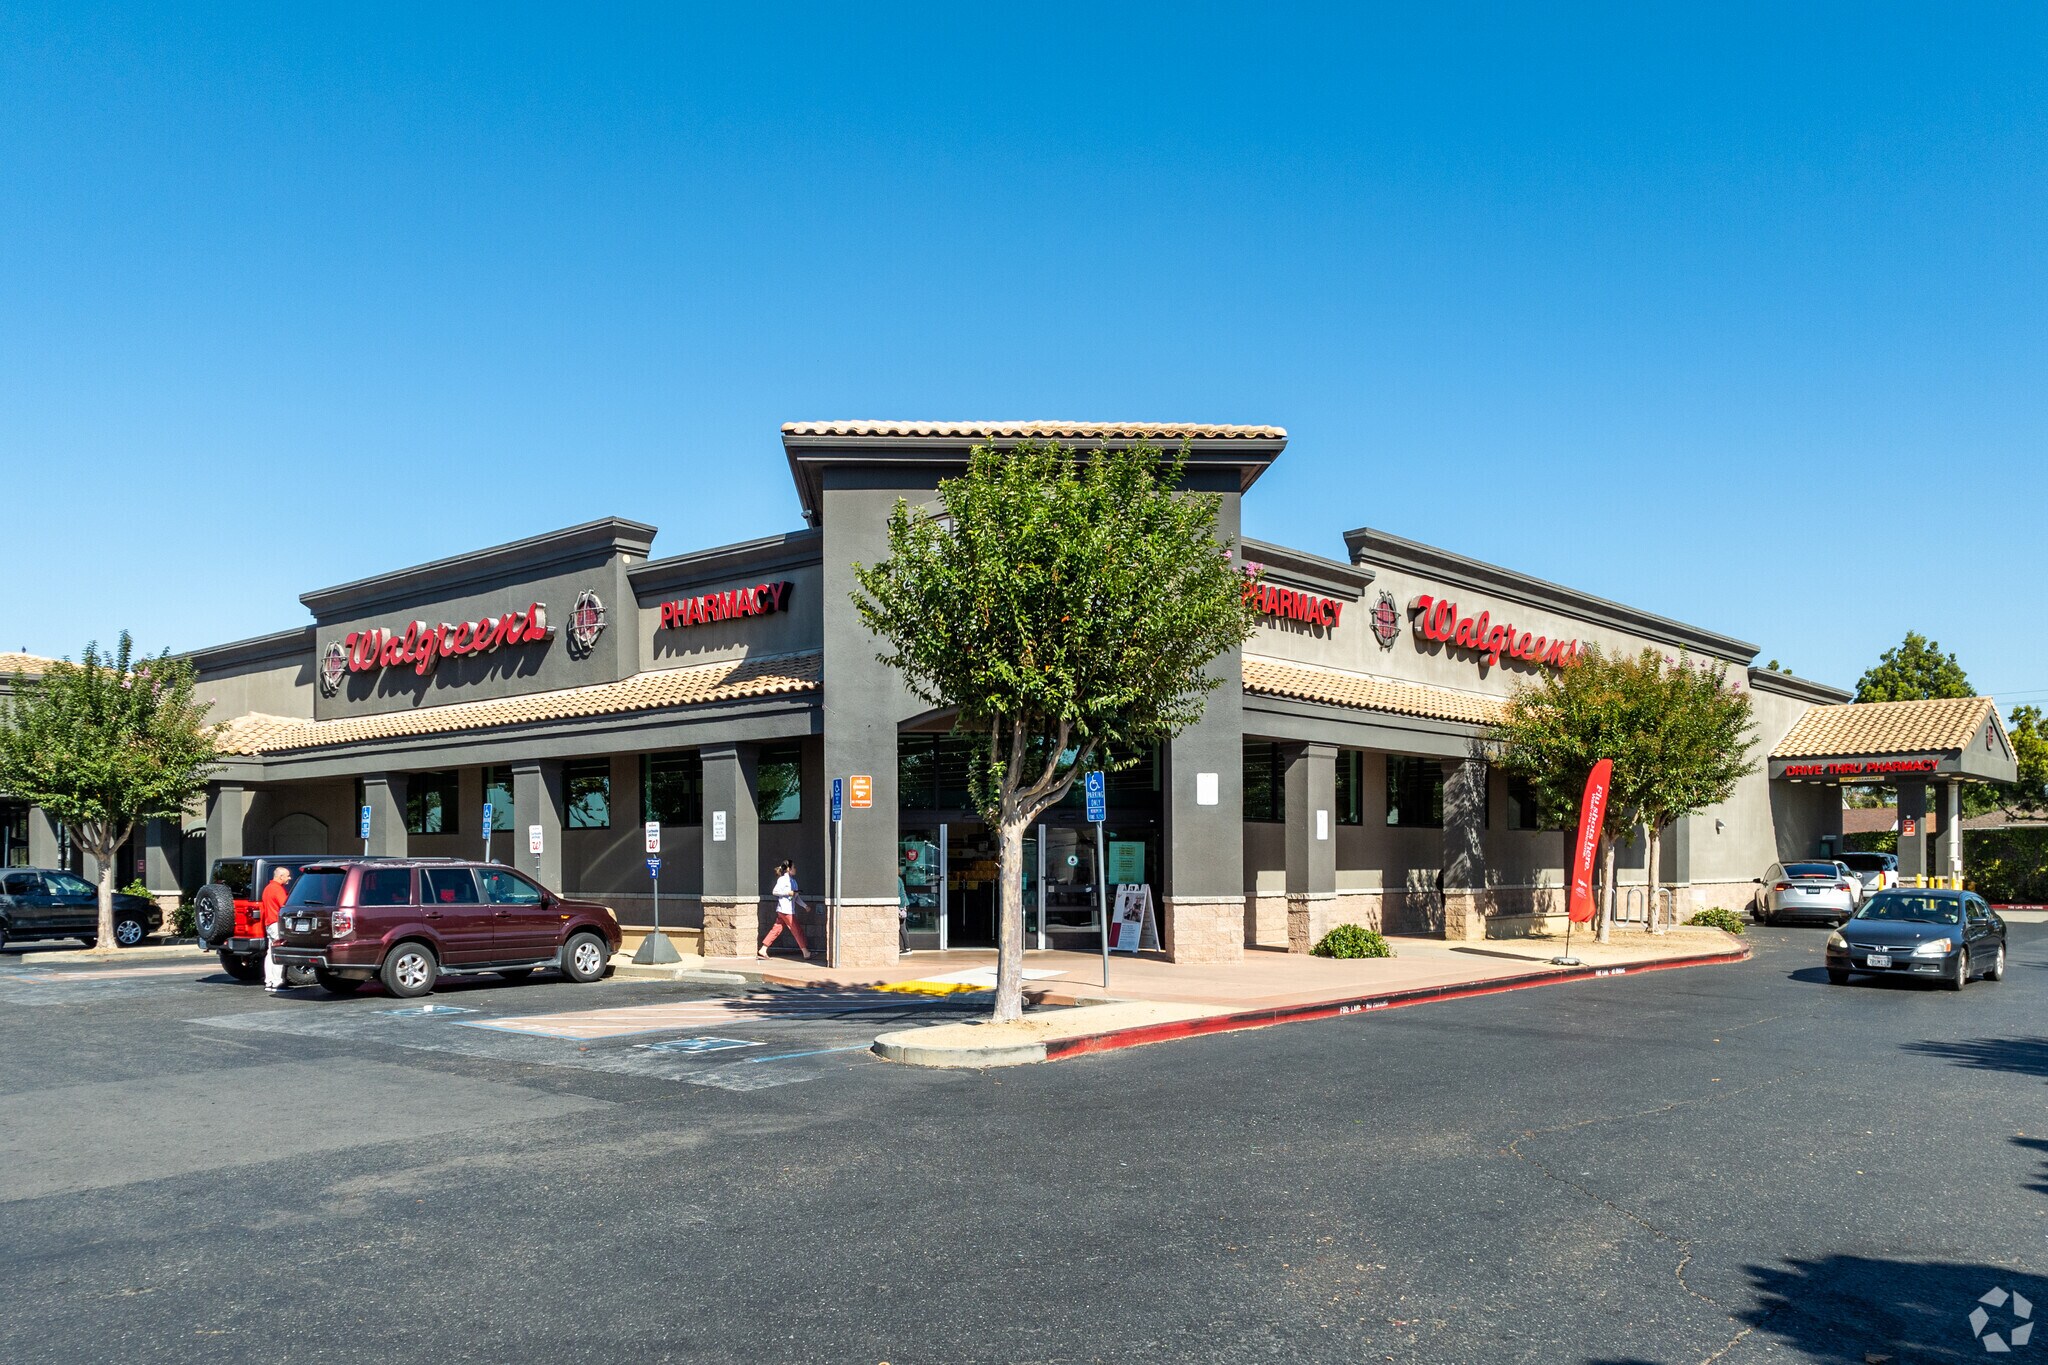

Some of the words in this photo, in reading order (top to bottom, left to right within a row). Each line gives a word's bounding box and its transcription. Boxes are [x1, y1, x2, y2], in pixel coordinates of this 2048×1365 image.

[660, 581, 788, 630] PHARMACY
[345, 602, 554, 675] Walgreens
[1412, 594, 1584, 667] Walgreens
[1785, 765, 1824, 776] DRIVE
[1827, 763, 1863, 775] THRU
[1865, 759, 1939, 773] PHARMACY
[1091, 799, 1101, 807] ONLY
[1594, 784, 1603, 805] Flu
[1588, 807, 1599, 840] shots
[1583, 841, 1595, 871] here.
